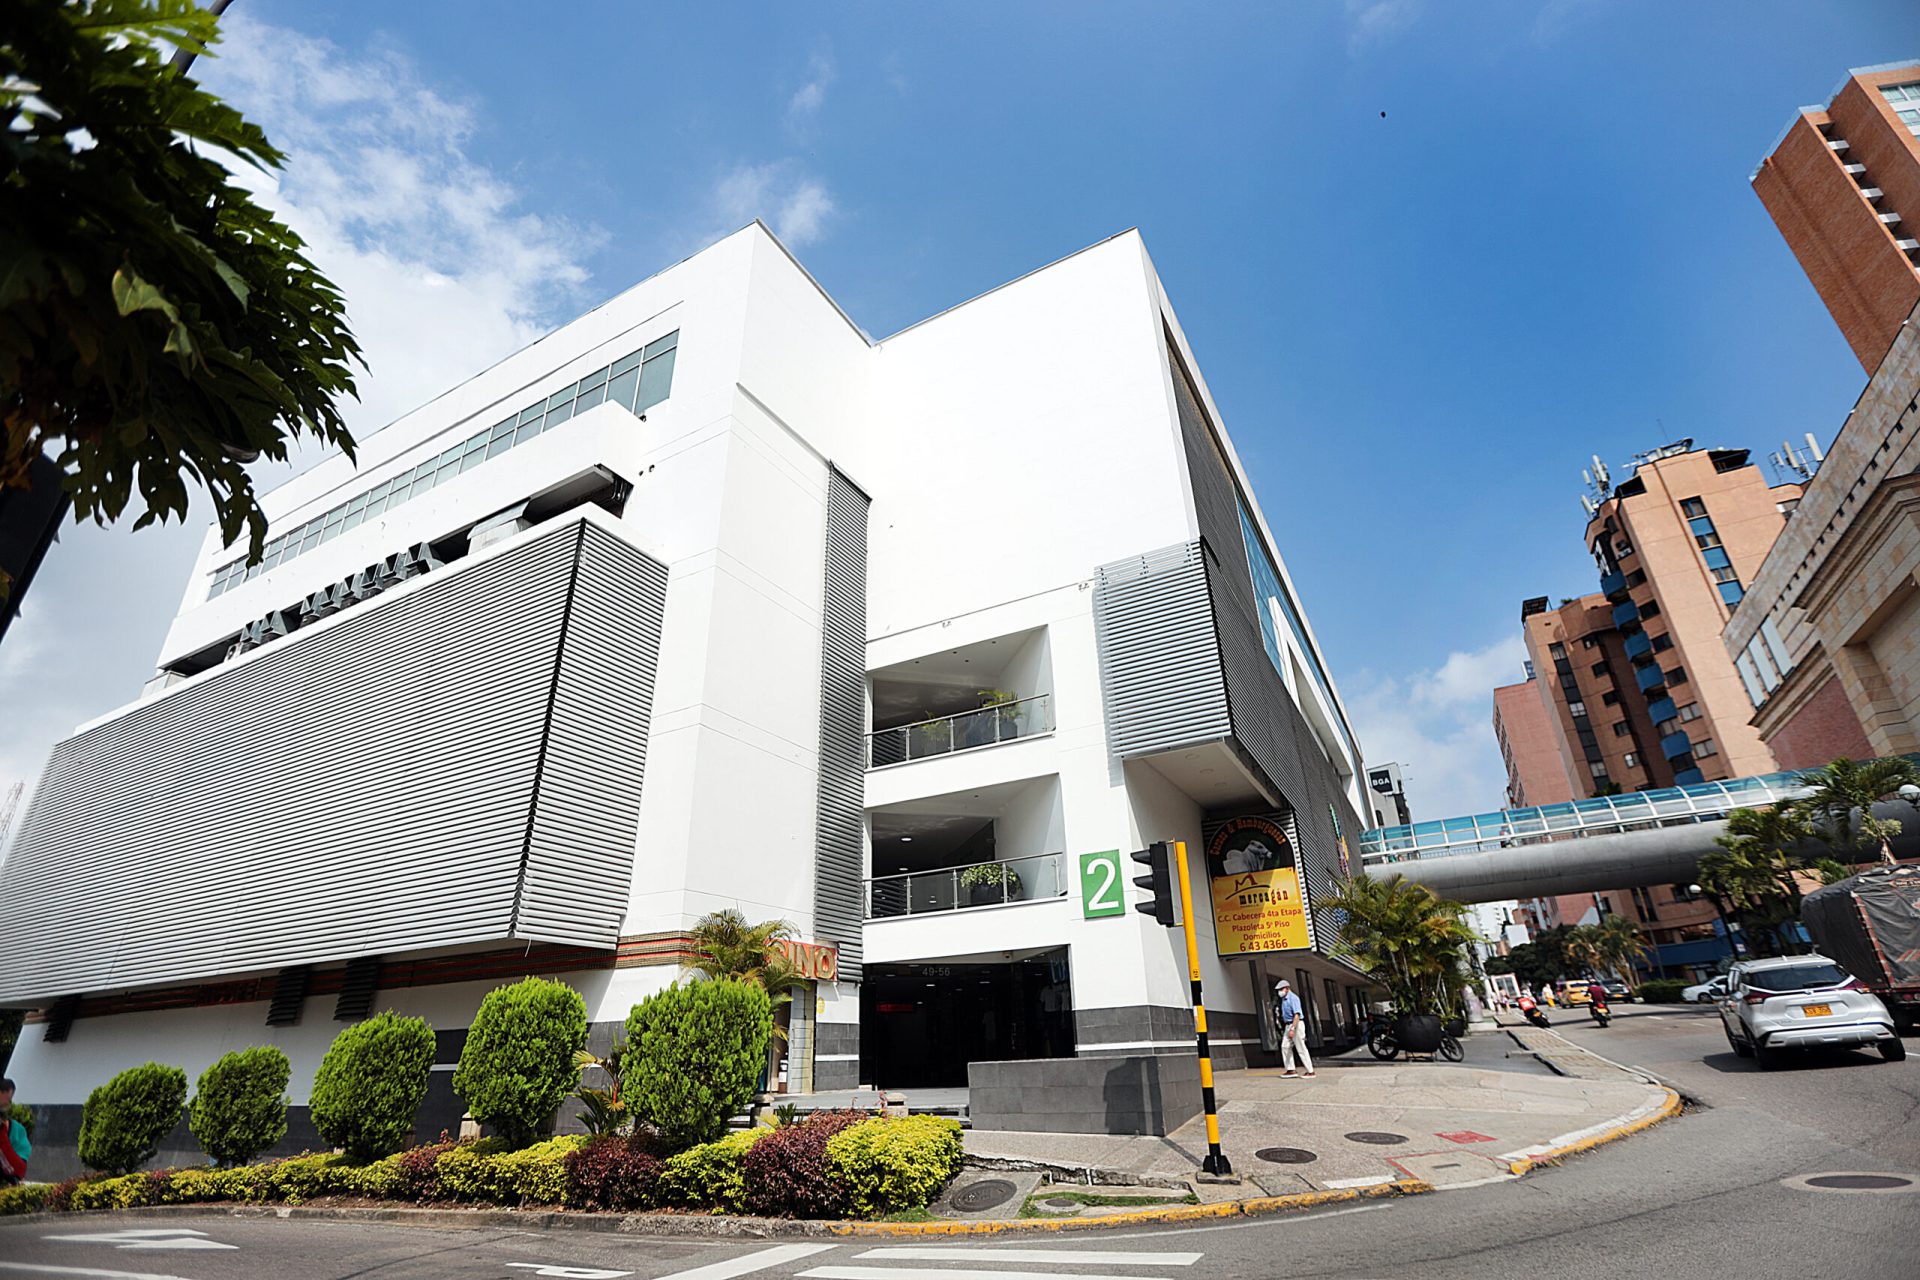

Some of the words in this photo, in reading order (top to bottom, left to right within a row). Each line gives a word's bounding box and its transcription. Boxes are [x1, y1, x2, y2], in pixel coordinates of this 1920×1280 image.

[1372, 778, 1390, 786] BGA
[1086, 858, 1119, 911] 2
[1233, 912, 1265, 921] Cabecera
[1281, 908, 1302, 916] Etapa
[1232, 923, 1265, 932] Plazoleta
[1274, 920, 1290, 928] Piso
[1243, 931, 1281, 941] Domicilios
[1263, 938, 1288, 949] 4366
[922, 967, 951, 977] 49-56
